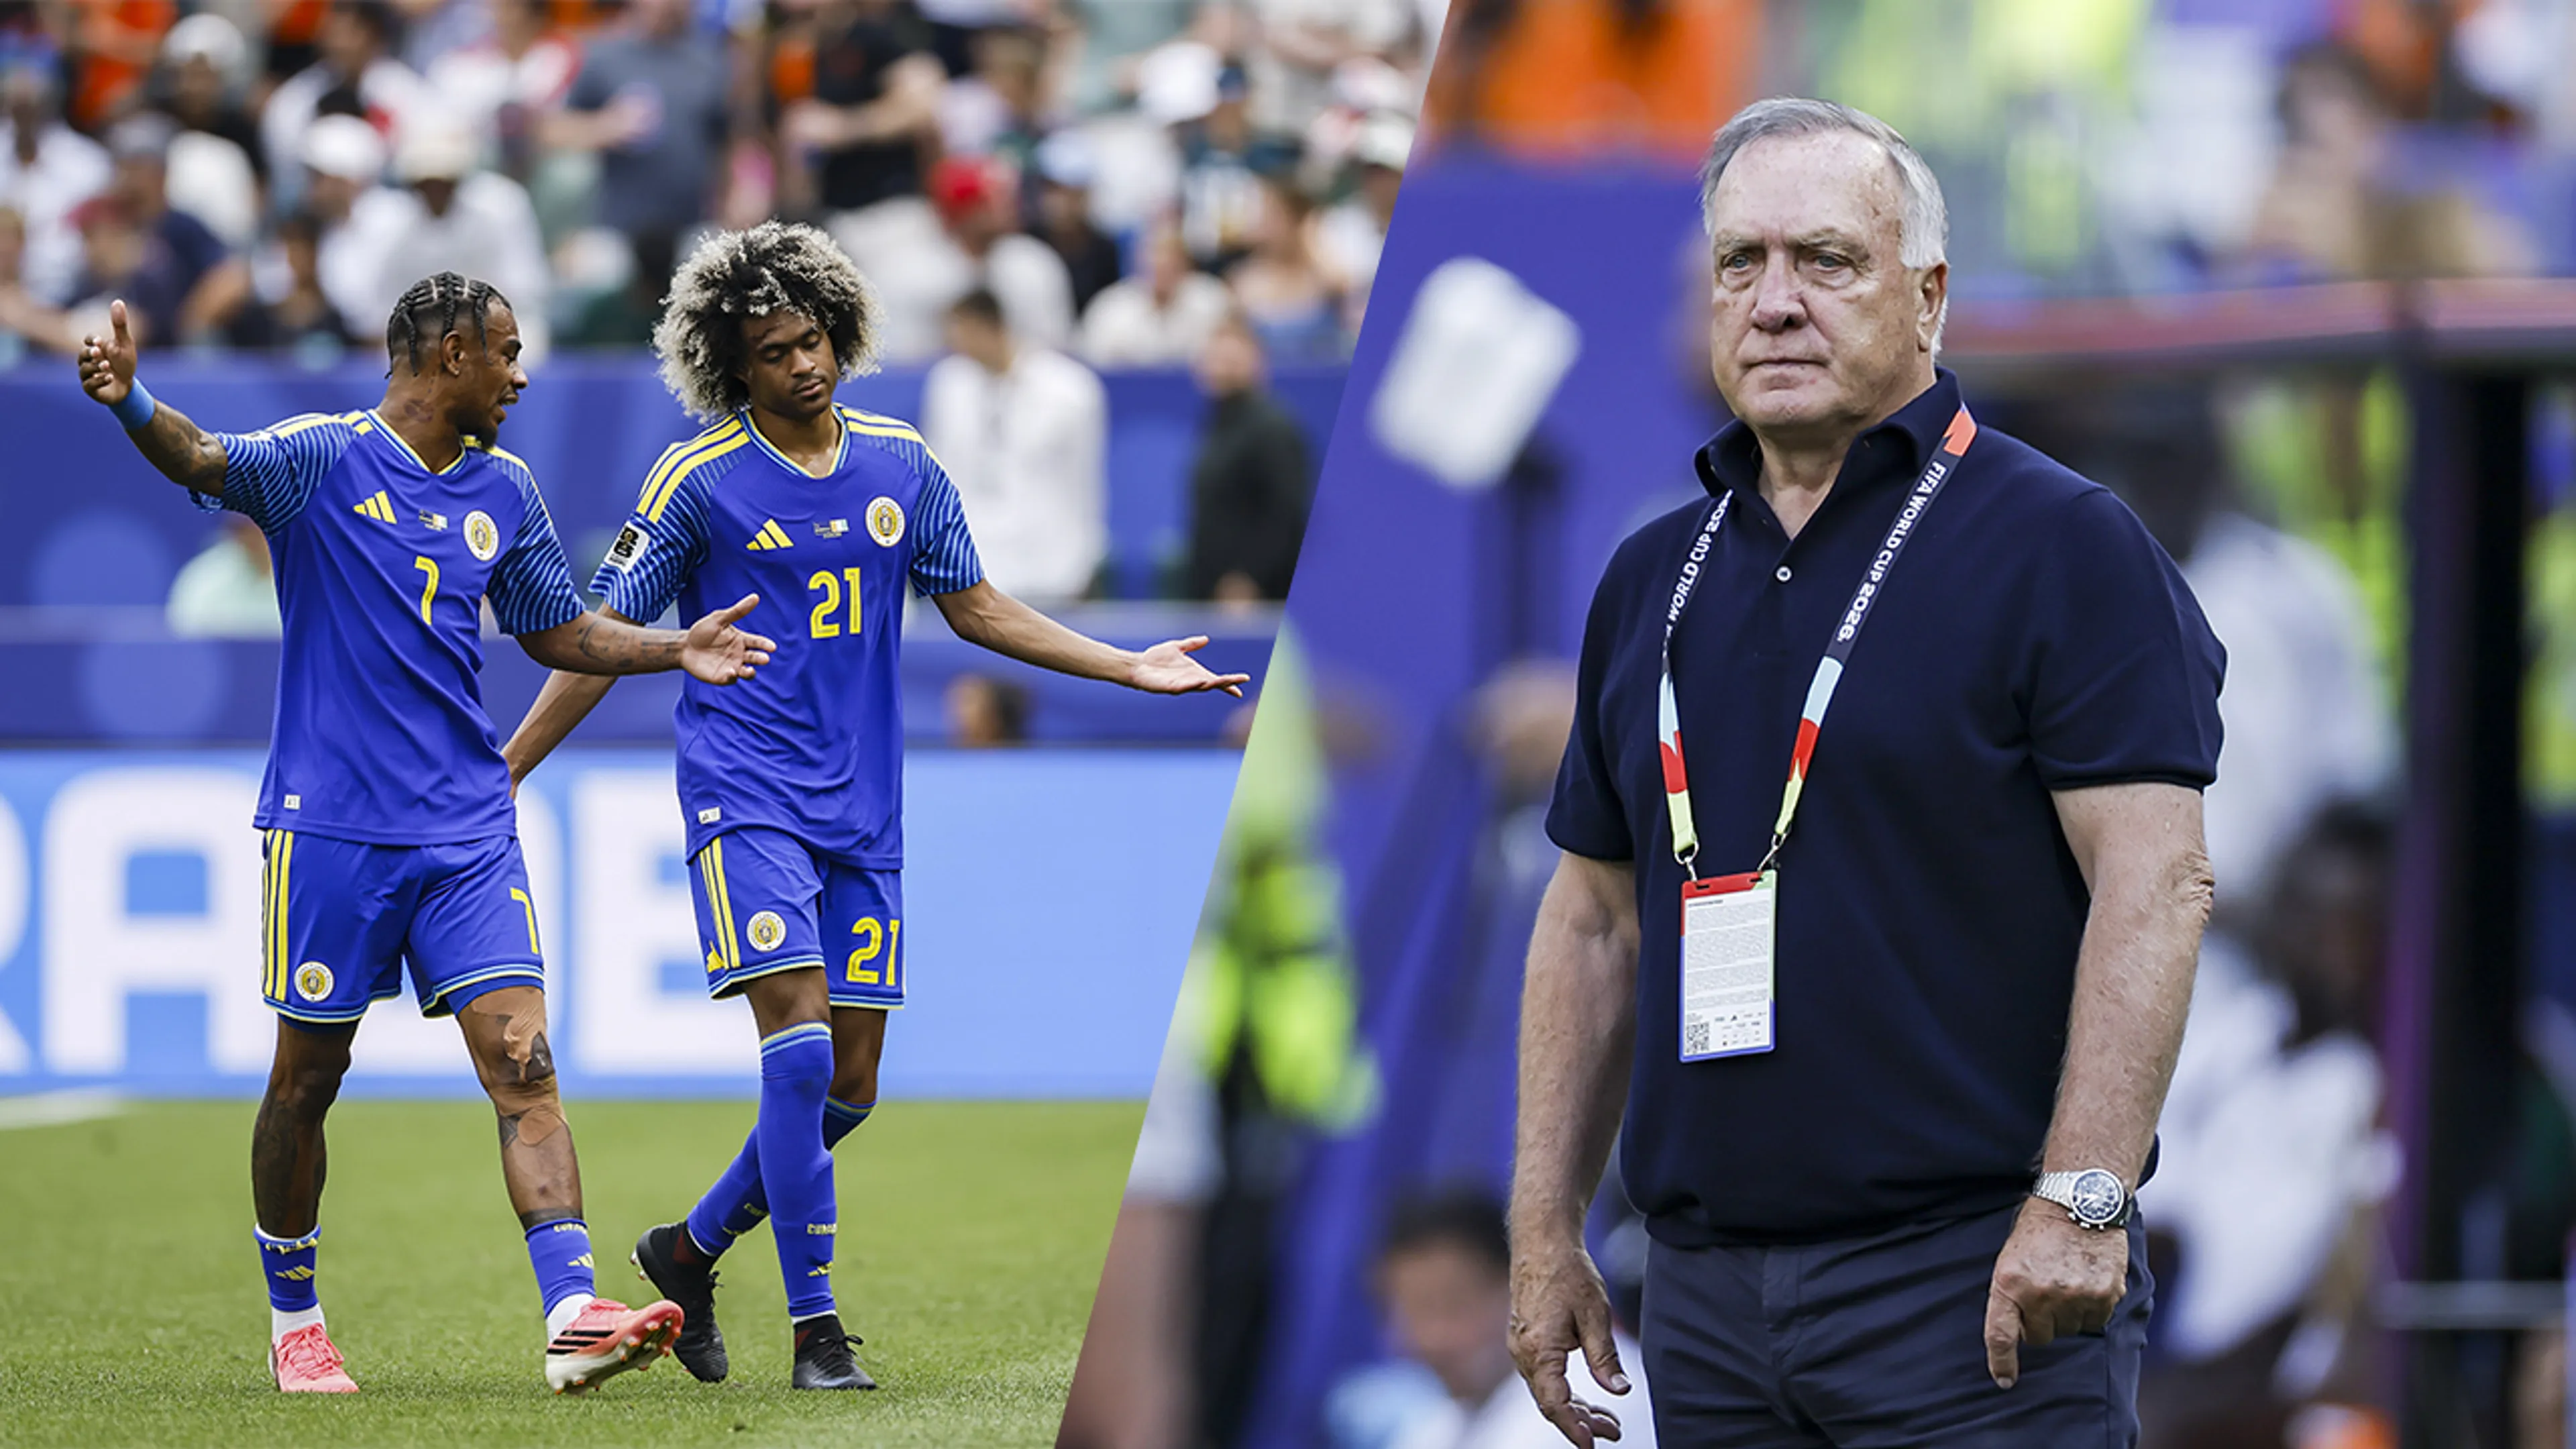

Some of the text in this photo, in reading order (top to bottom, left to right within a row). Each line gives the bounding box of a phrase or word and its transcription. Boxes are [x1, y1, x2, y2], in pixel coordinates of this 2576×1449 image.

[1668, 561, 1700, 621] WORLD
[1689, 533, 1712, 562] CUP
[1837, 461, 1947, 643] FIFA WORLD CUP 2026
[415, 555, 440, 626] 7
[808, 567, 863, 639] 21
[846, 917, 900, 987] 21
